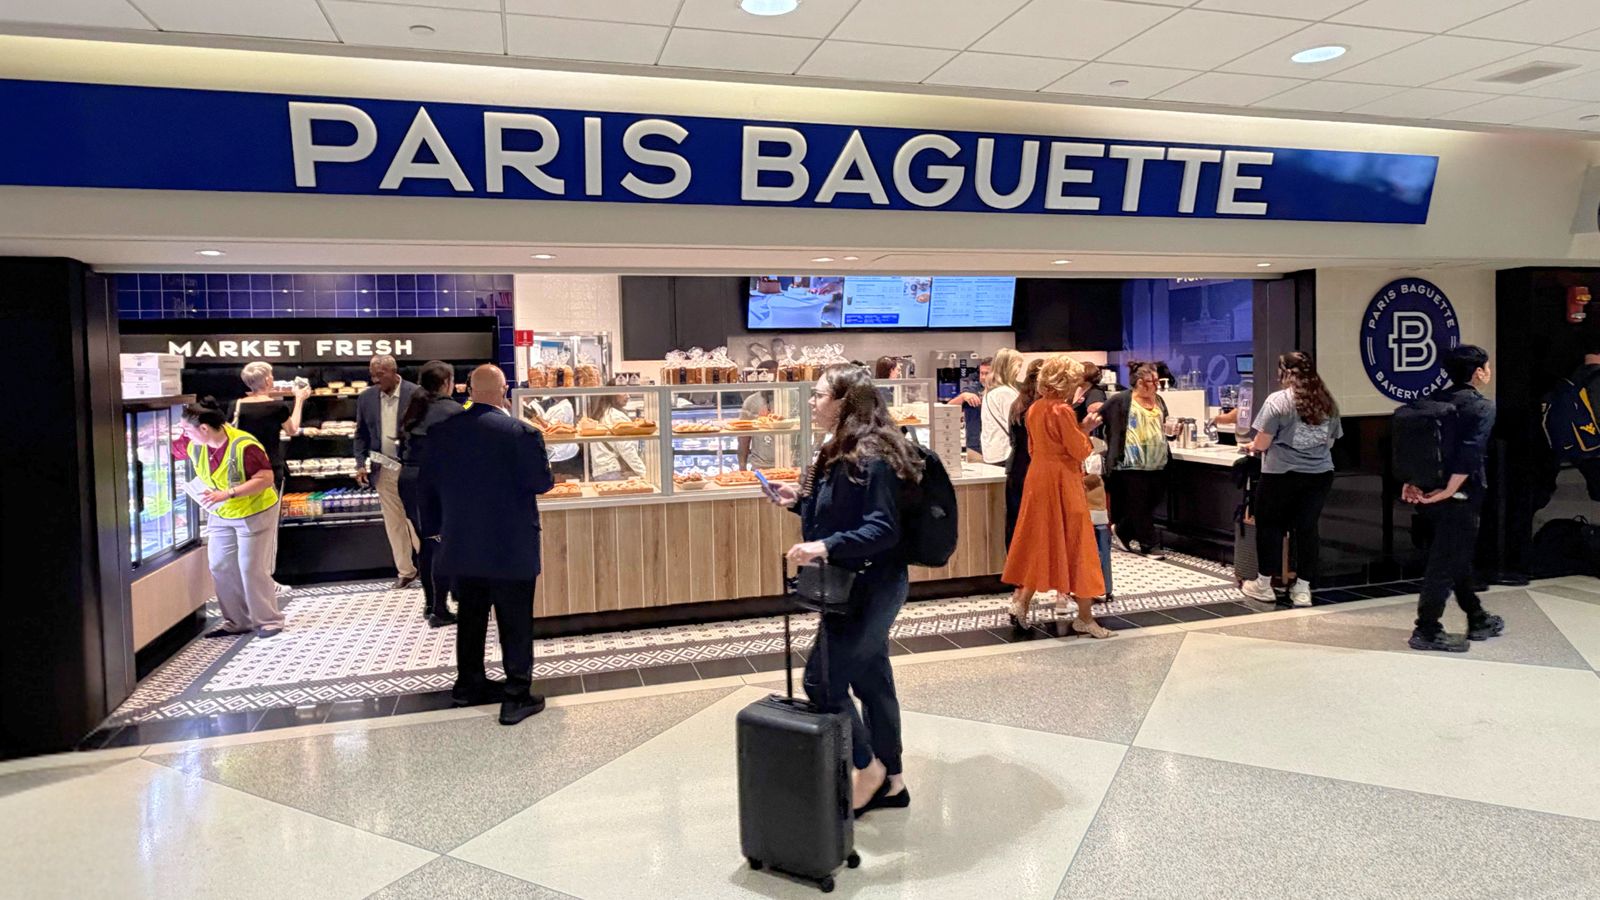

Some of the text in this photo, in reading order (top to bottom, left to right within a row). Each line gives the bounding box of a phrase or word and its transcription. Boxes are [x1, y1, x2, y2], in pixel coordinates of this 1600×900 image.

[288, 101, 1274, 214] PARIS BAGUETTE
[1368, 284, 1455, 329] PARIS BAGUETTE
[168, 339, 413, 357] MARKET FRESH
[1376, 371, 1419, 399] BAKERY
